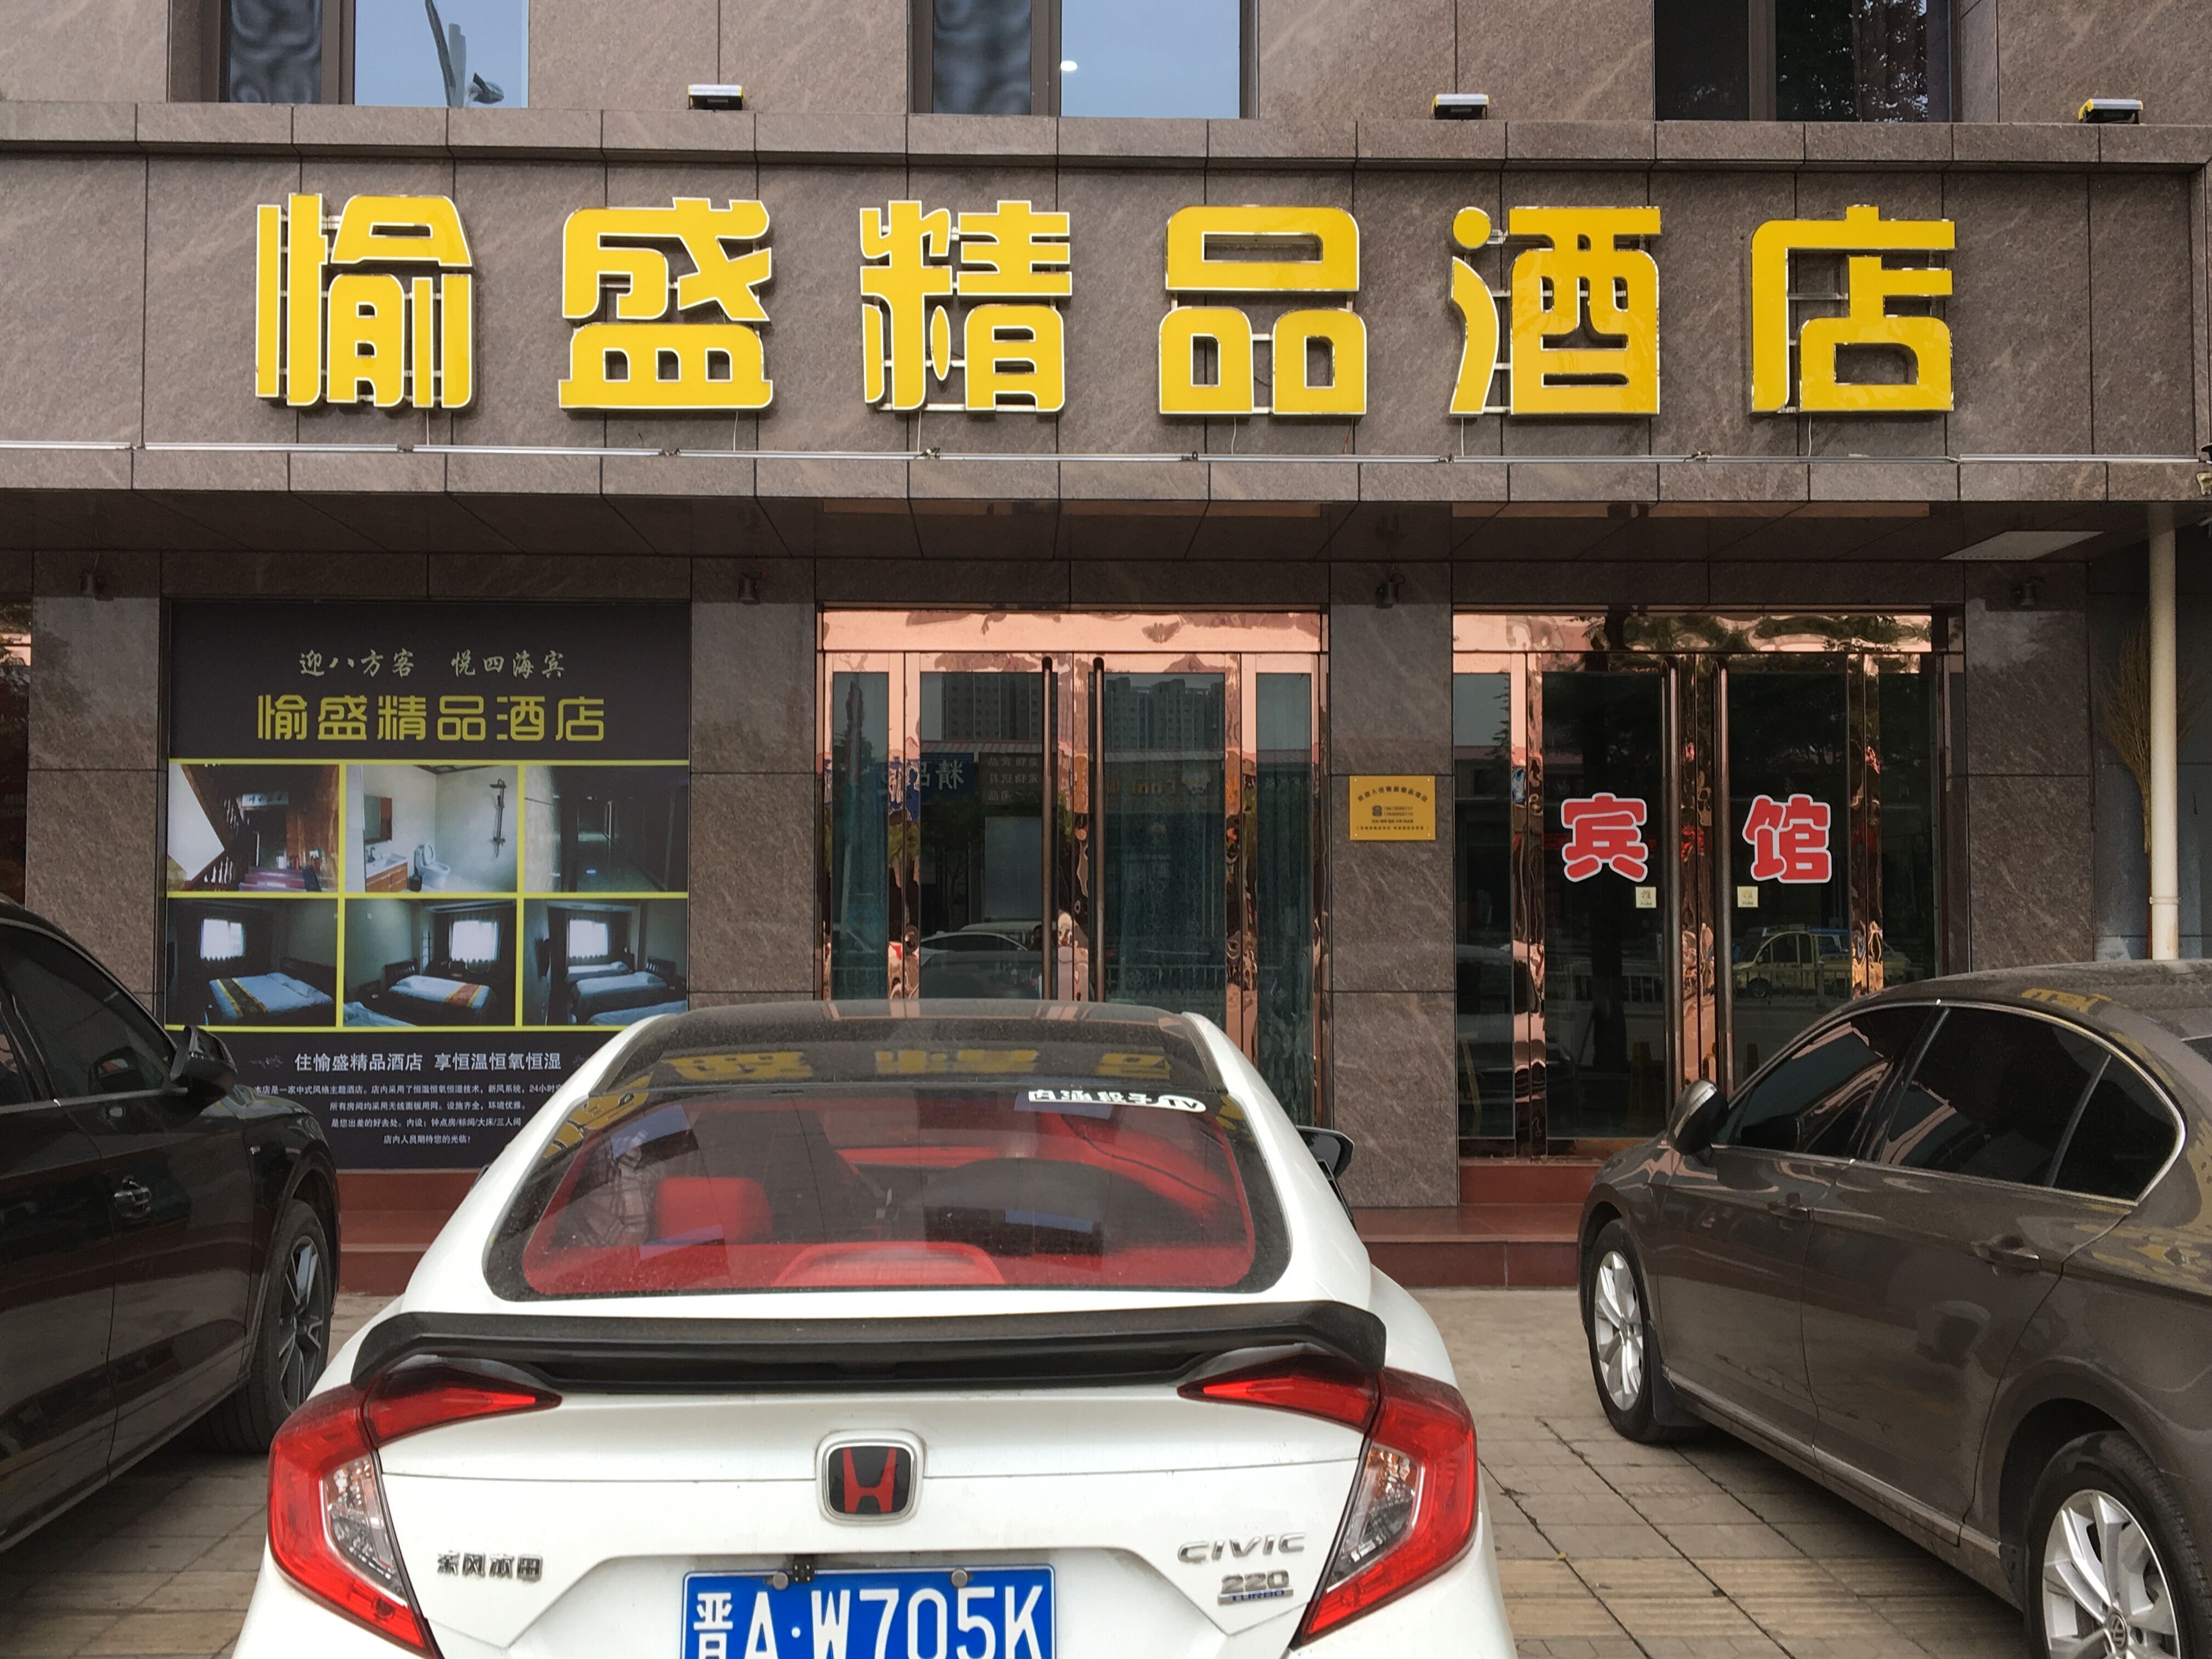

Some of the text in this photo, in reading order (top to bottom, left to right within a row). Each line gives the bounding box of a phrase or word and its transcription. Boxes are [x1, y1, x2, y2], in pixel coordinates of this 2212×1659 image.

[256, 193, 1957, 418] 愉盛精品酒店
[299, 650, 565, 679] 迎八方客 悦四海宾
[258, 695, 605, 741] 愉盛精品酒店
[1561, 792, 1832, 884] 宾馆
[295, 1052, 562, 1072] 住愉盛精品酒店 享恒温恒氧恒湿
[1178, 1532, 1306, 1562] CIVIC
[437, 1550, 543, 1582] 东风本田
[1221, 1569, 1289, 1594] 220
[1232, 1589, 1285, 1602] TURBO
